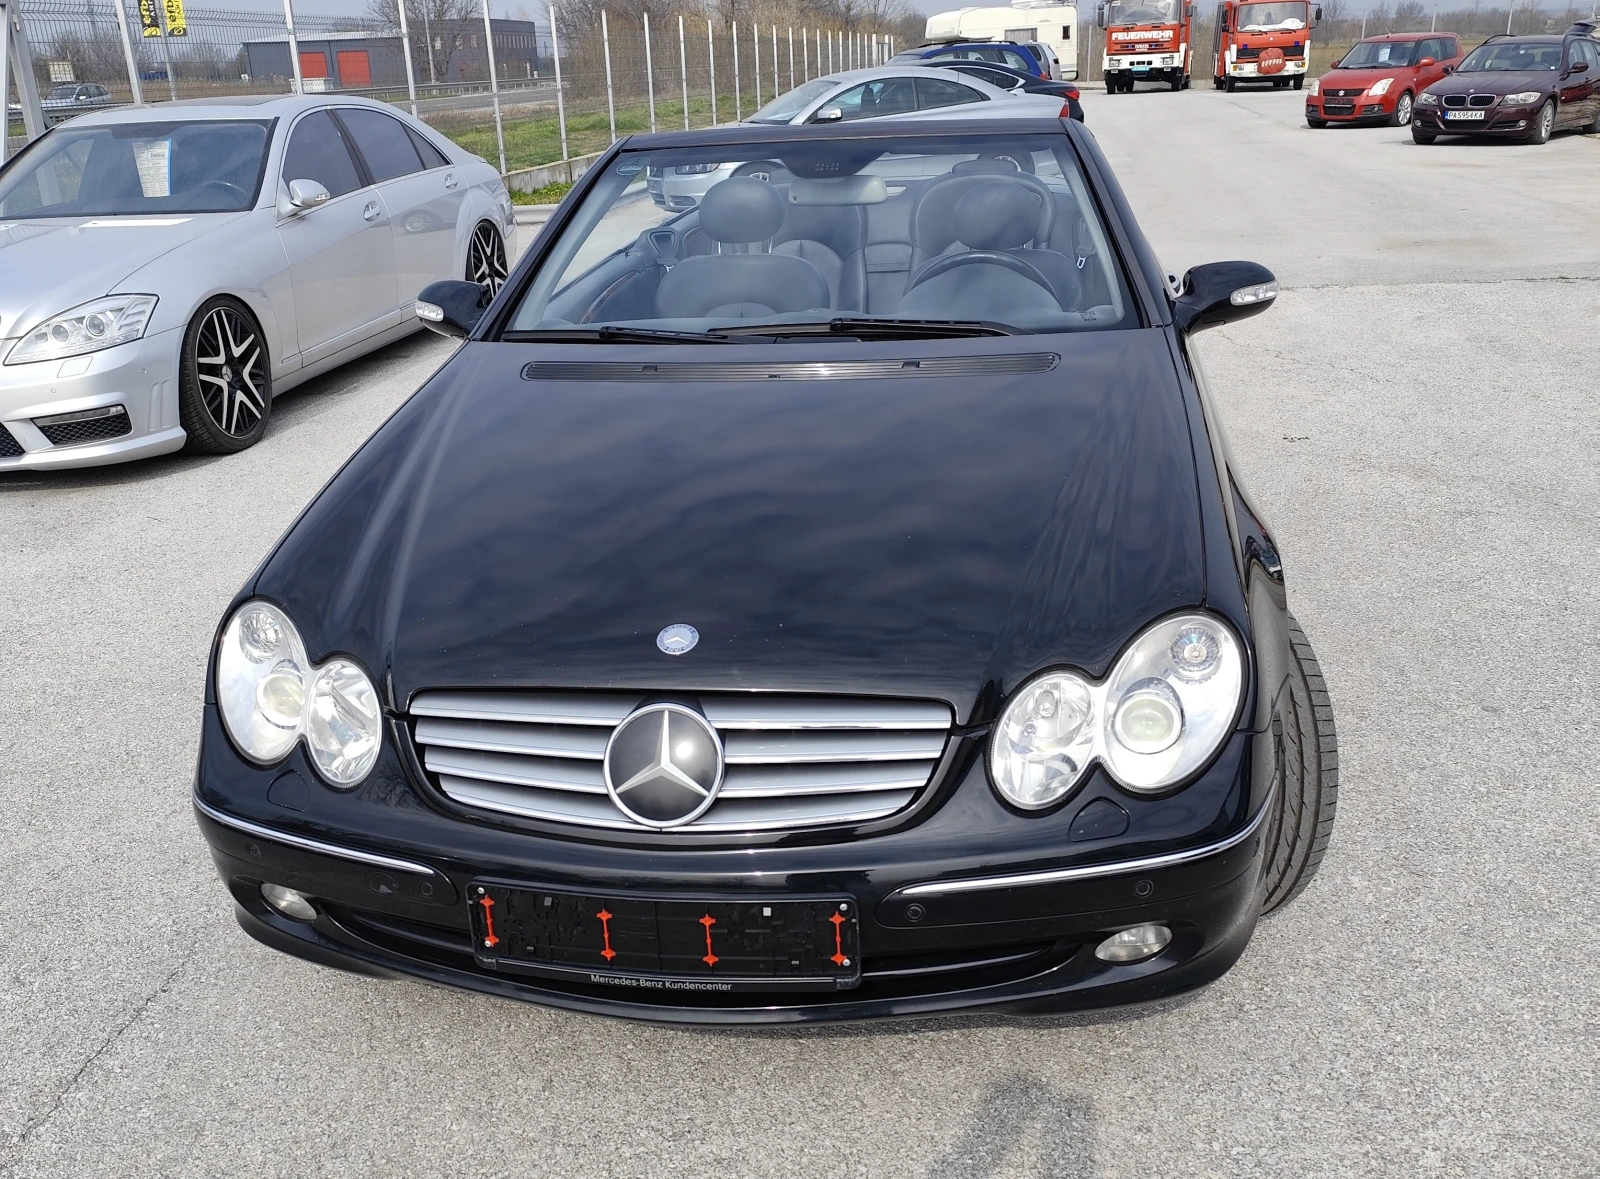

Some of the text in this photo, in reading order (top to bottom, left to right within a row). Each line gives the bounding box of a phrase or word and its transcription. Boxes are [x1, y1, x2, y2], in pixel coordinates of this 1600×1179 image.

[1112, 30, 1174, 40] FEUERWEHR
[590, 974, 732, 991] Mercedes-Benz Kundencenter
